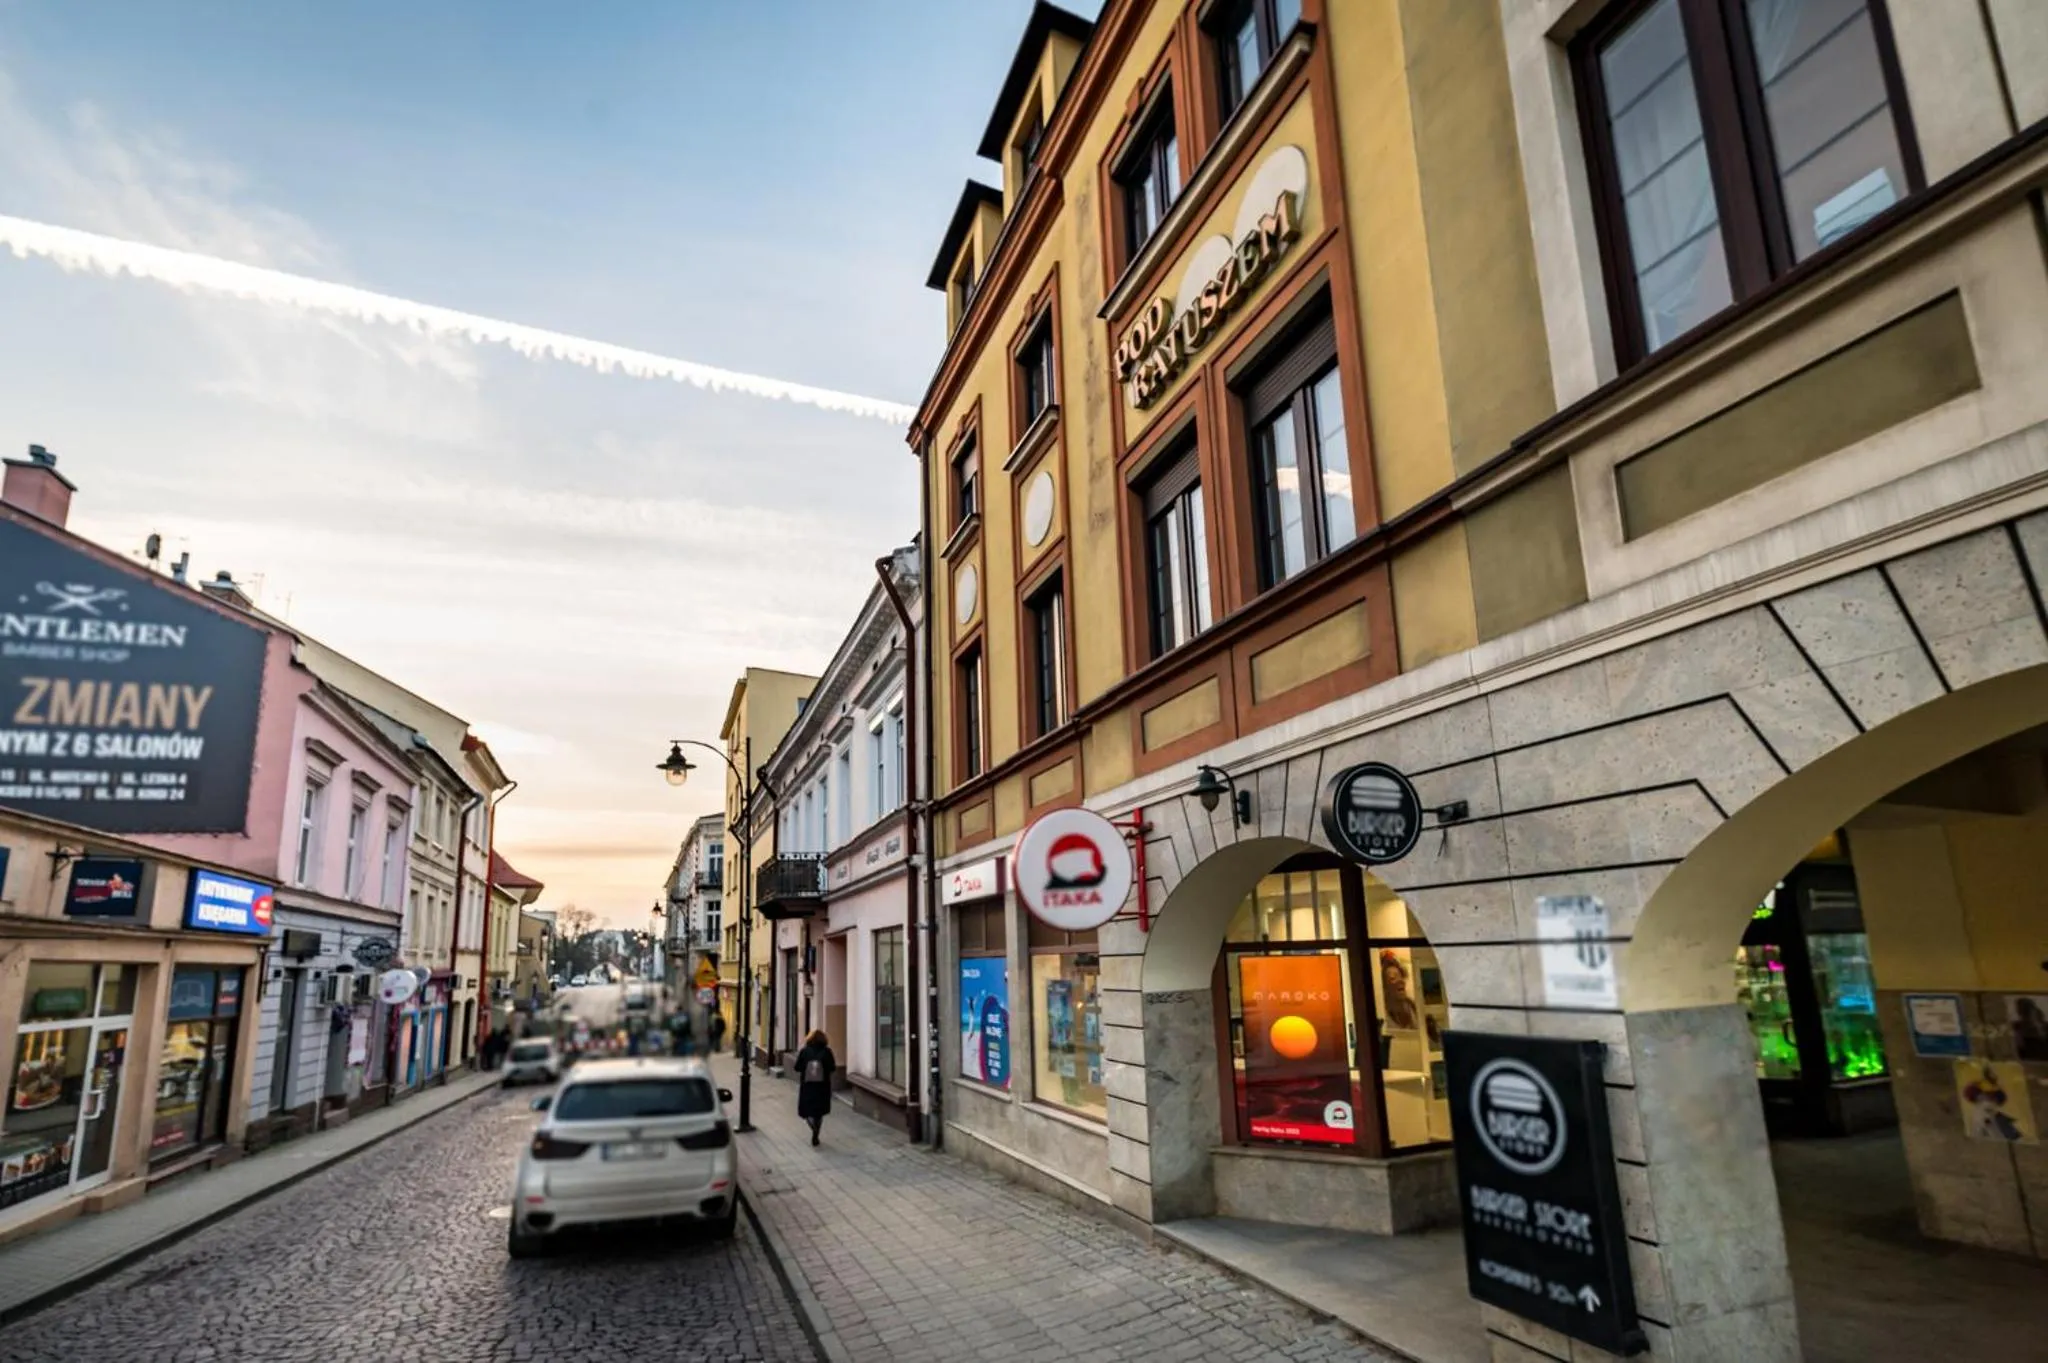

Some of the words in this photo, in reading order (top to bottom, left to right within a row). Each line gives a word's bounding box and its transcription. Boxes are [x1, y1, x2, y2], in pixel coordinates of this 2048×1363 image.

[1131, 189, 1300, 409] RATUSZEM
[1114, 296, 1173, 382] POD
[0, 612, 188, 647] NTLEMEN
[14, 676, 213, 730] ZMIANY
[51, 731, 71, 757] Z
[94, 732, 204, 760] SALONÓW
[1042, 888, 1103, 908] ITAKA
